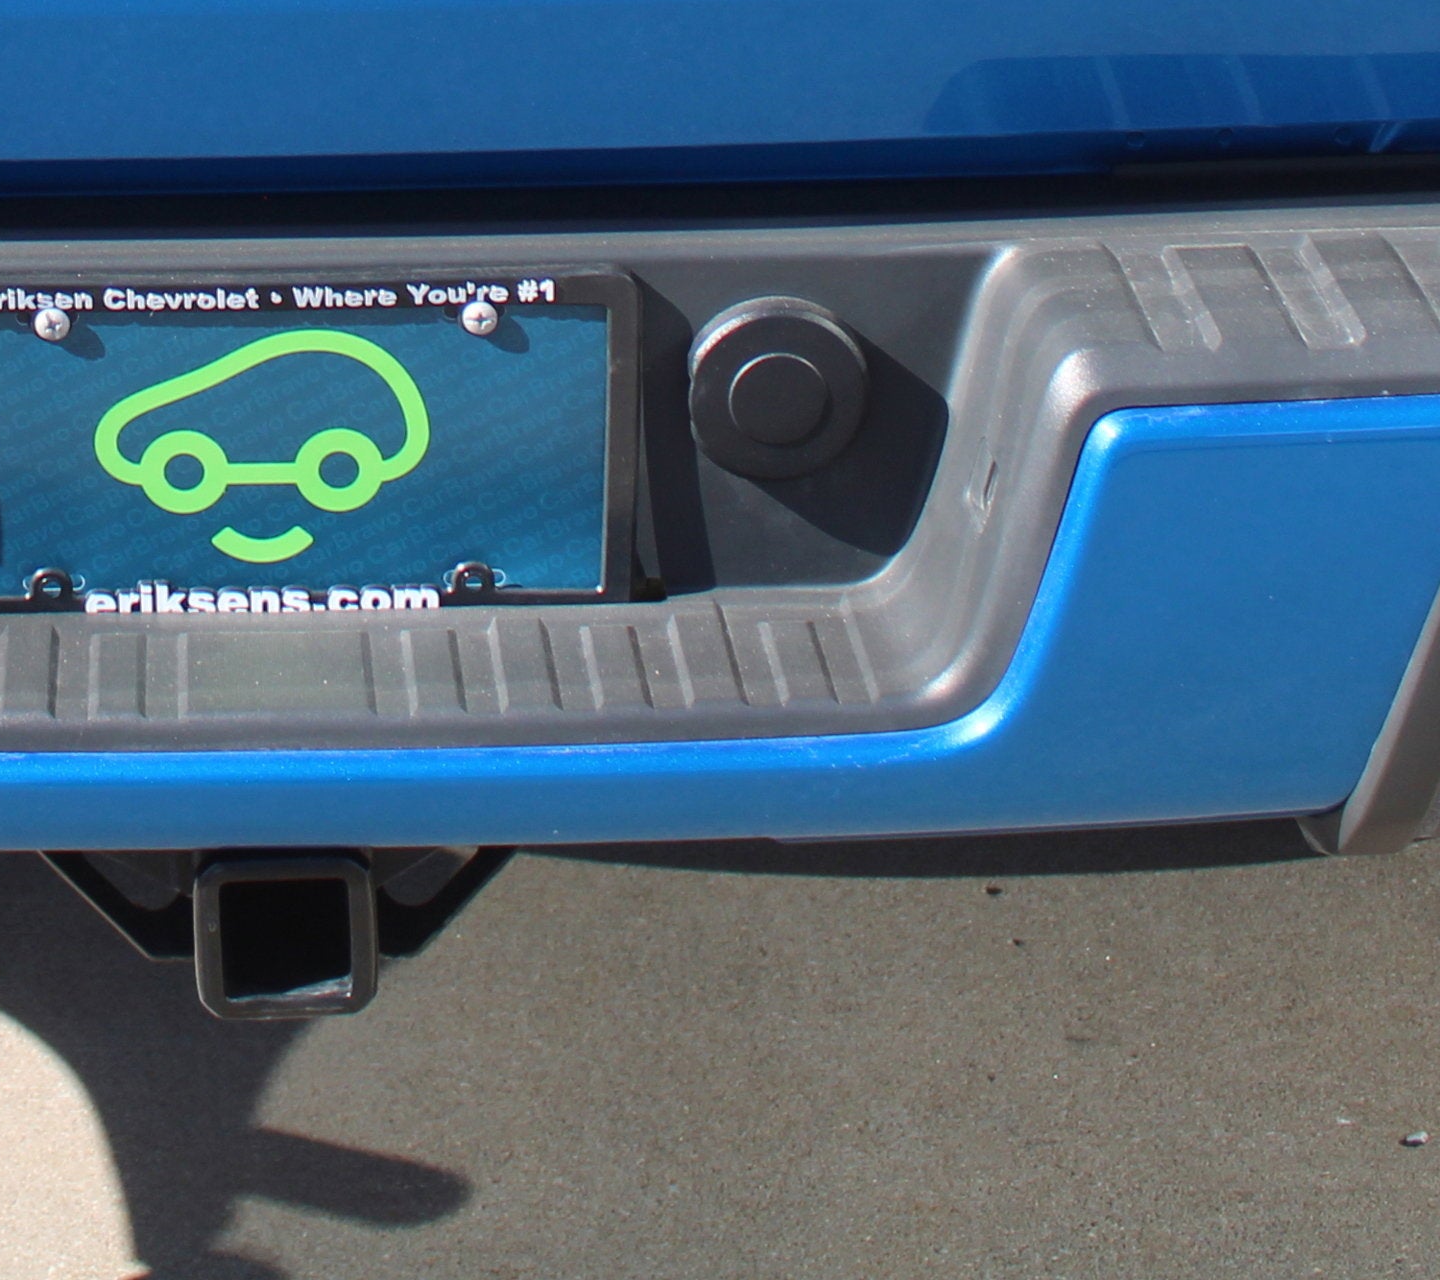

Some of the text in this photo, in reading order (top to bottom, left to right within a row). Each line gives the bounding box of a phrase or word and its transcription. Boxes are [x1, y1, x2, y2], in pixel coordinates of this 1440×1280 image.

[103, 287, 261, 310] Chevrolet
[292, 285, 398, 308] Where
[406, 280, 510, 306] You're
[517, 278, 556, 303] #1
[85, 579, 440, 613] eriksens.com
